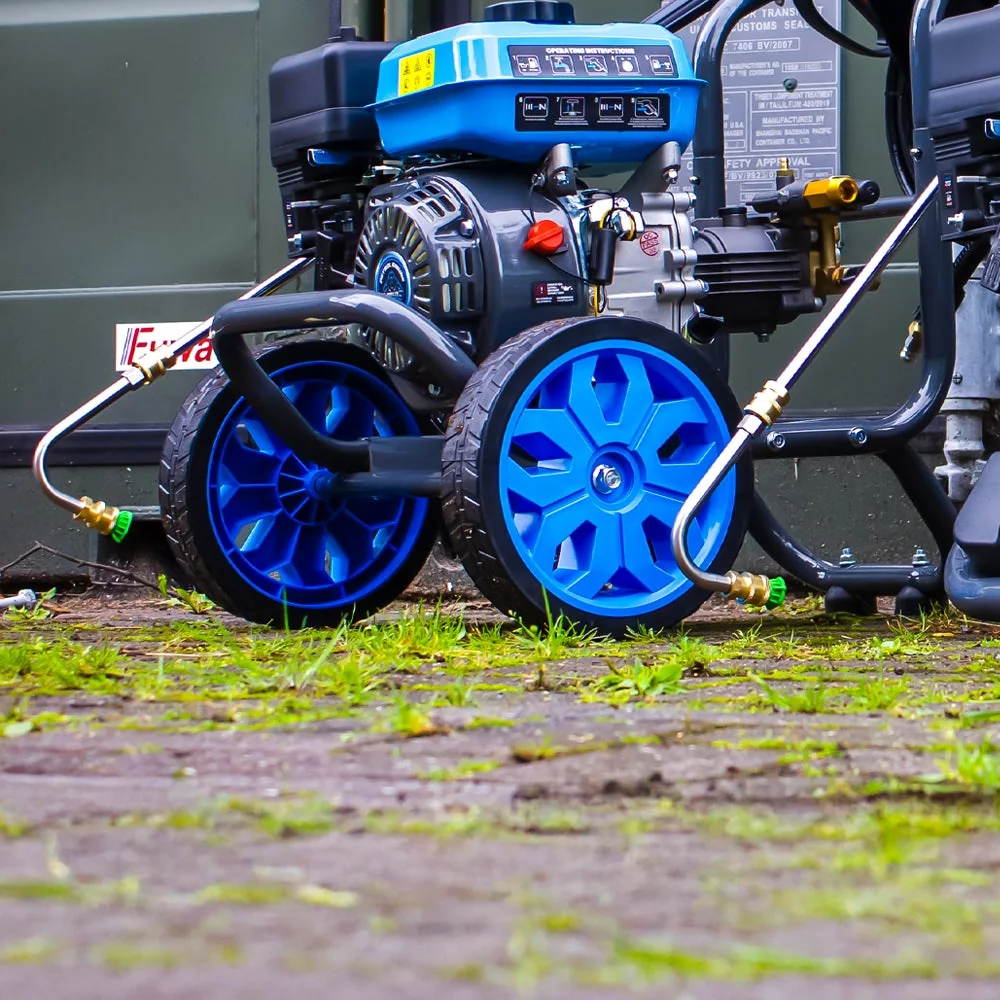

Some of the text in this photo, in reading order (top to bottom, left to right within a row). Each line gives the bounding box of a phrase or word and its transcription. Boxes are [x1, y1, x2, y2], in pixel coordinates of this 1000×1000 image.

[761, 6, 824, 19] TRANST
[727, 159, 751, 168] FETY
[127, 327, 213, 366] Fa
